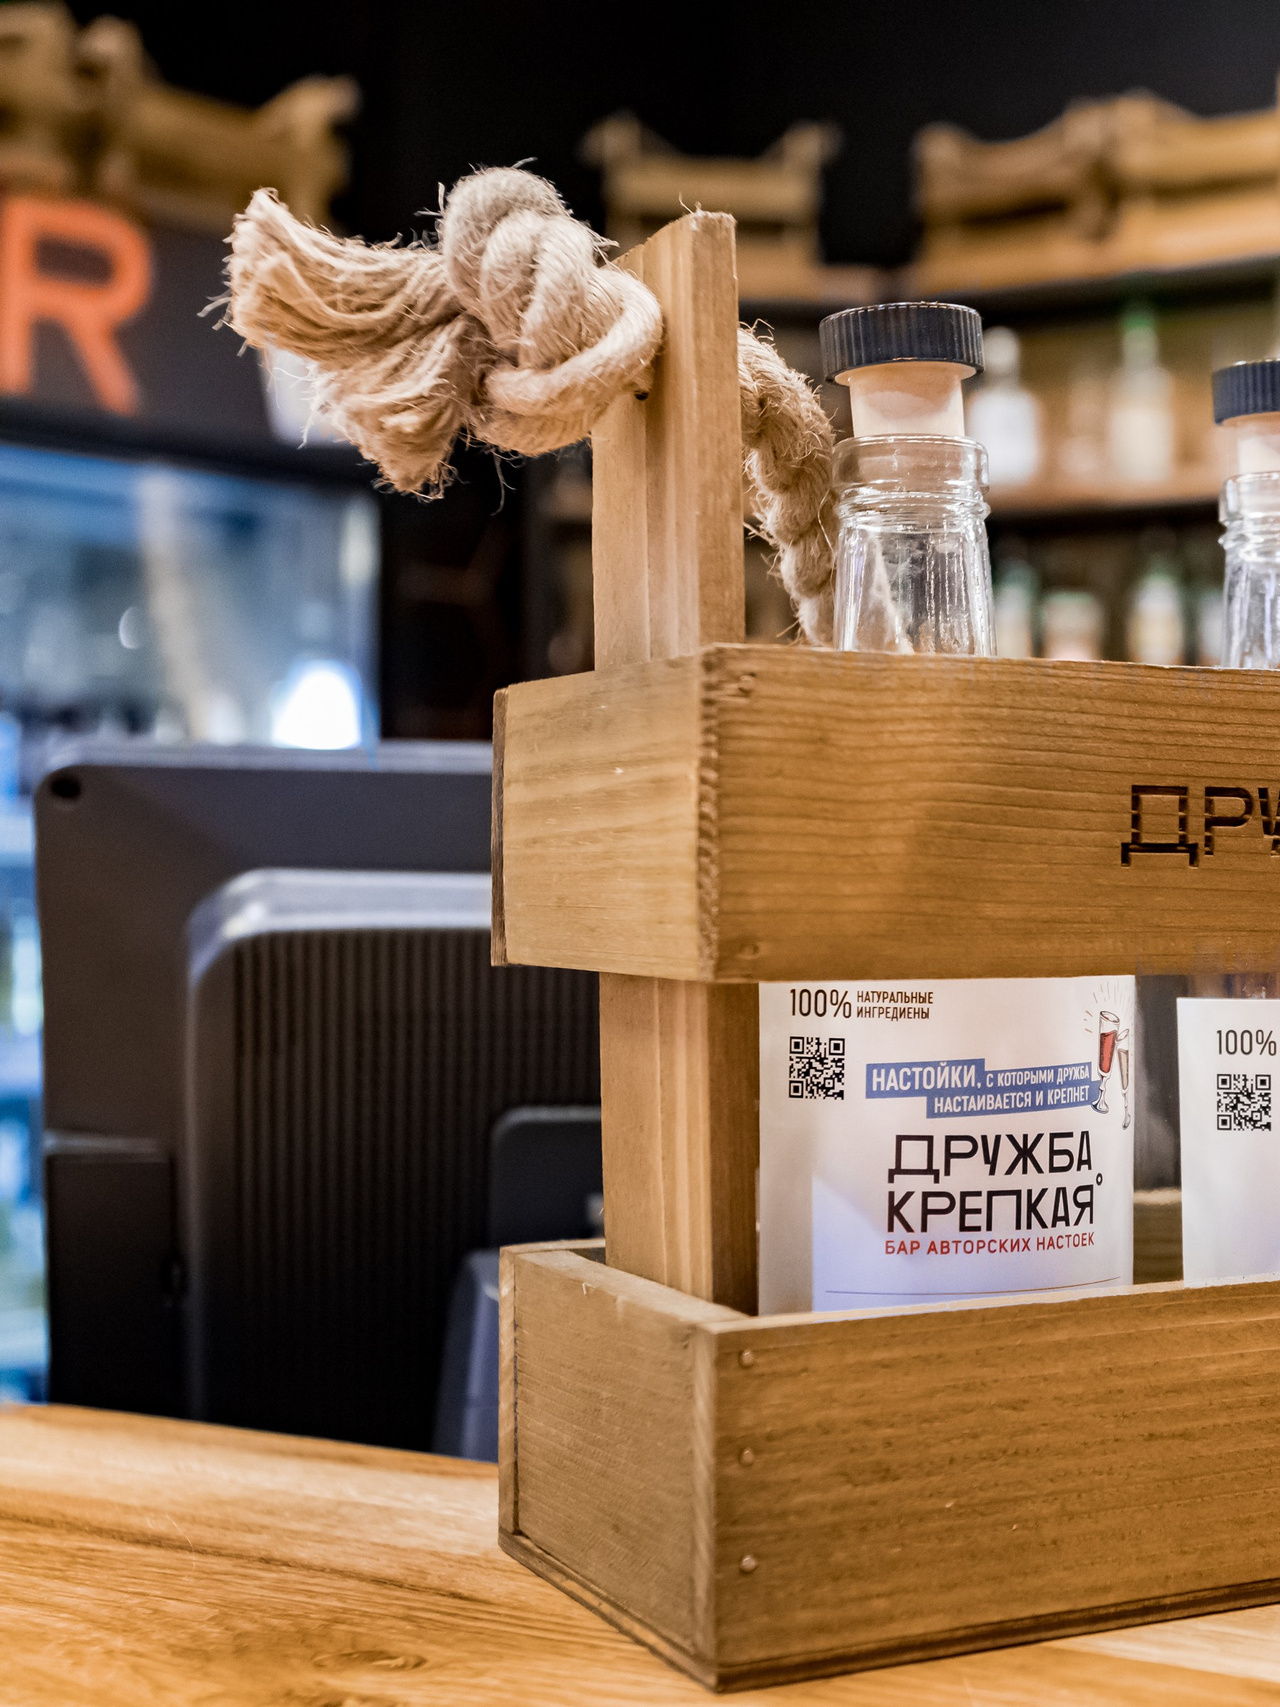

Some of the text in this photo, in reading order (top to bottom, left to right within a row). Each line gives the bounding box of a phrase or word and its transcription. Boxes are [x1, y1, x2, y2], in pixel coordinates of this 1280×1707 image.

[789, 987, 853, 1020] 100%
[856, 990, 934, 1006] НАТУРАЛЬНЫЕ
[856, 1005, 931, 1022] ИНГРЕДИЕНЫ
[1216, 1029, 1277, 1057] 100%
[872, 1062, 981, 1092] НАСТОЙКИ,
[997, 1070, 1054, 1088] КОТОРЫМИ
[1056, 1065, 1090, 1085] ДРУЖБА
[933, 1085, 1090, 1114] НАСТАИВАЕТСЯ И КРЕПНЕТ
[887, 1130, 1093, 1184] ДРУЖБА
[884, 1231, 1096, 1256] БАР АВТОРСКИХ НАСТОЕК
